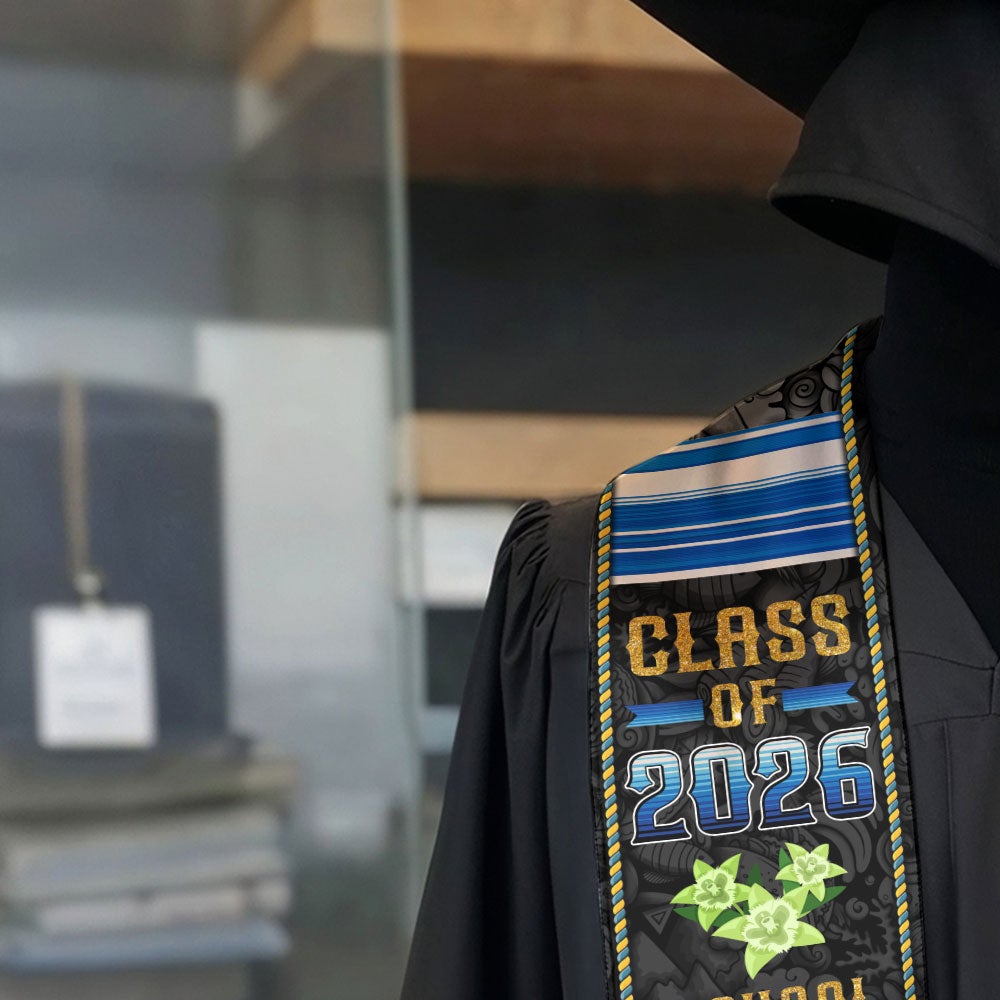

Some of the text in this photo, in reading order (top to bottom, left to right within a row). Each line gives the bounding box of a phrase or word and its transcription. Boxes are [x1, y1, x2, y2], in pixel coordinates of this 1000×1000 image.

[626, 594, 851, 677] CLASS
[709, 678, 777, 728] OF
[624, 726, 877, 846] 2026
